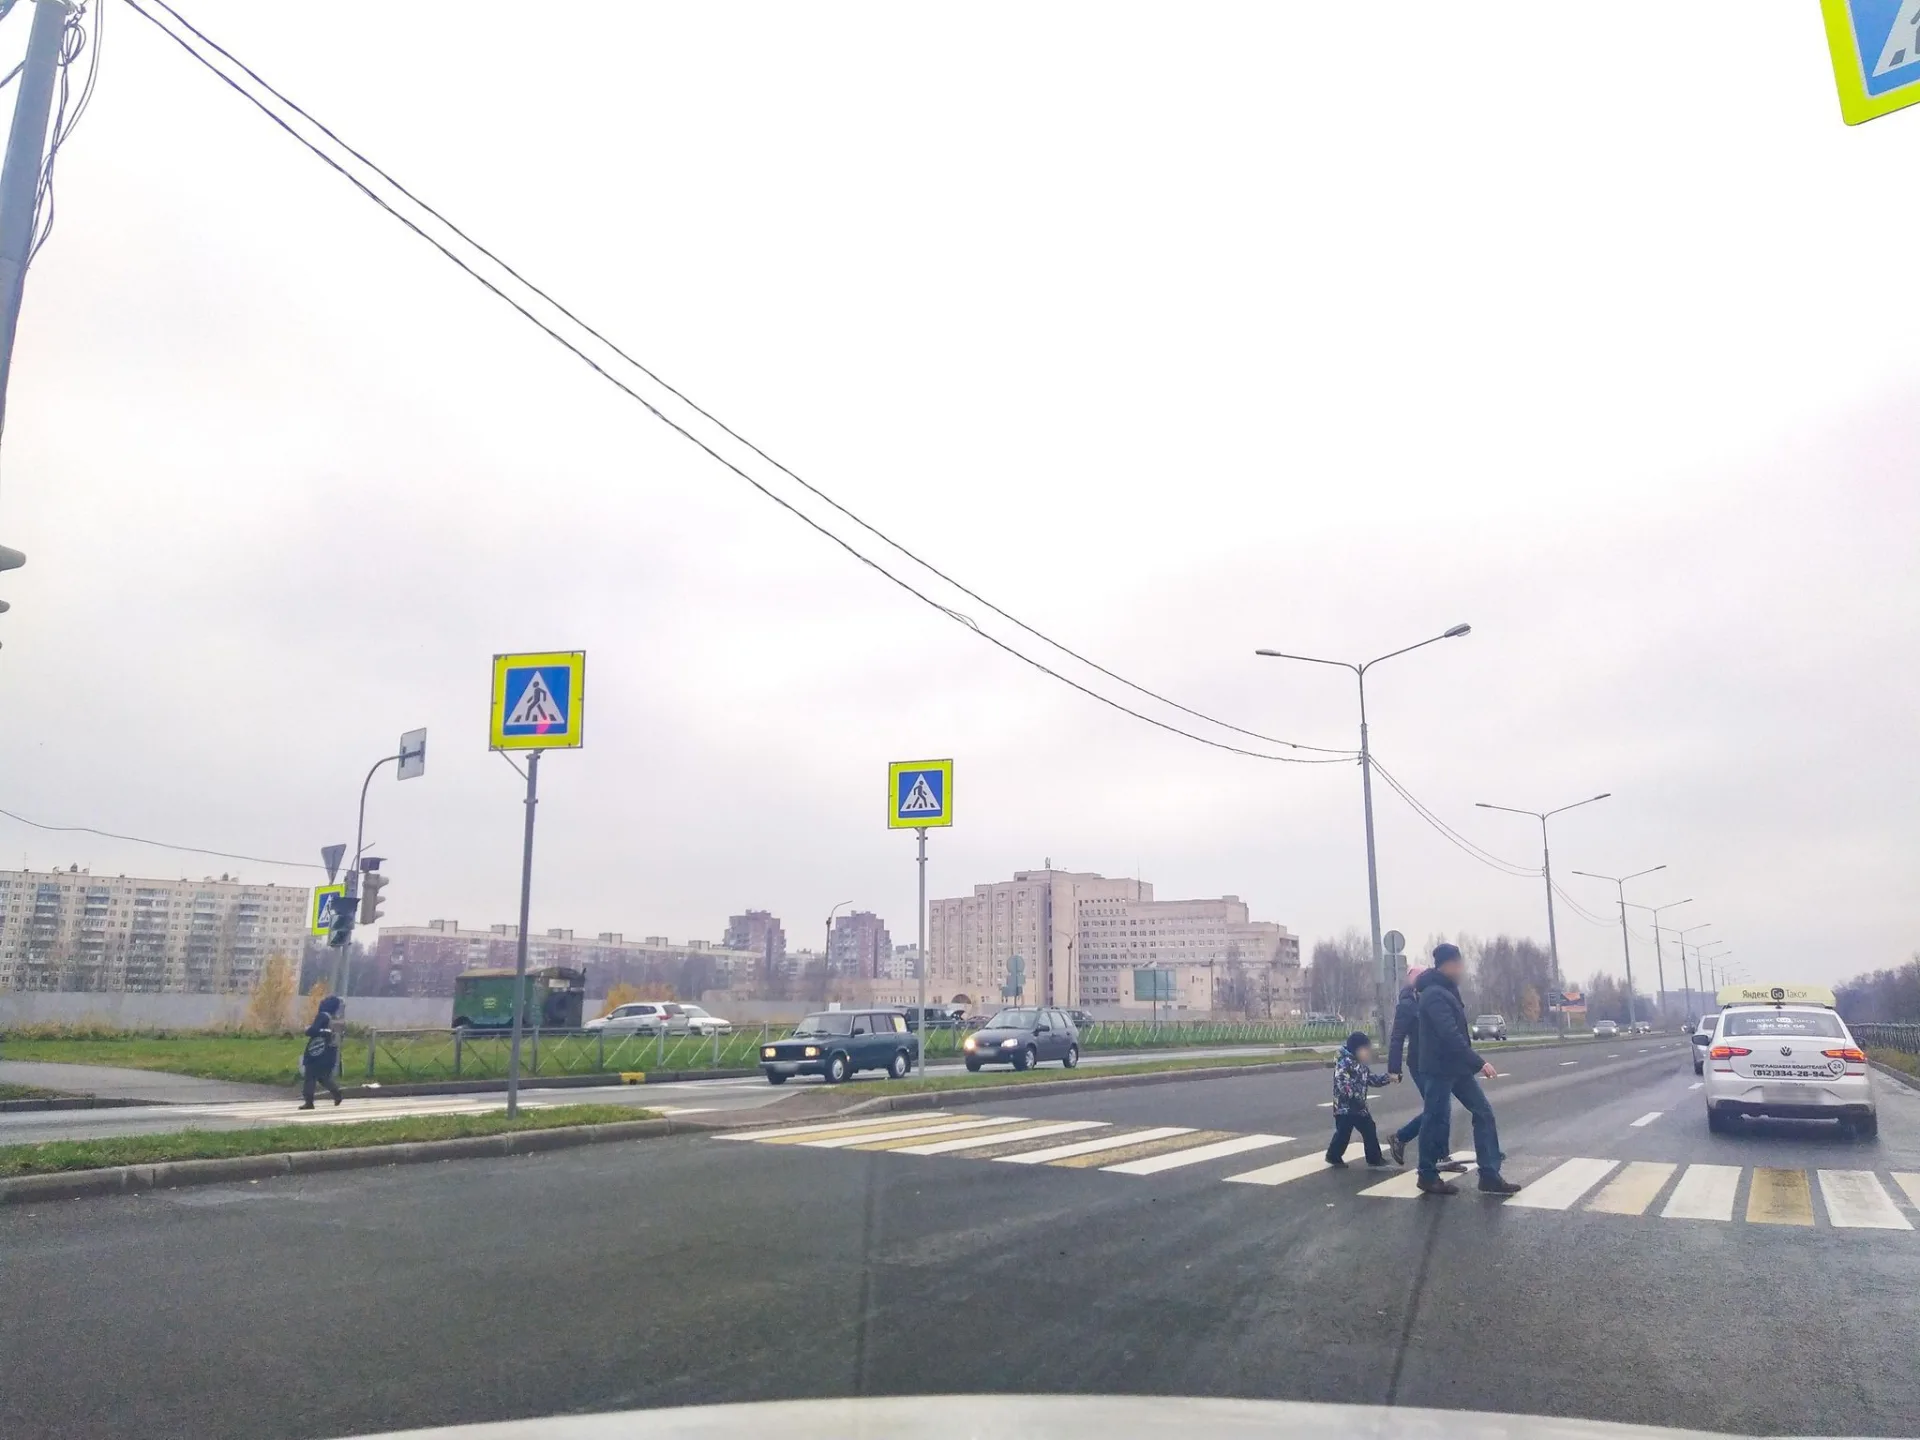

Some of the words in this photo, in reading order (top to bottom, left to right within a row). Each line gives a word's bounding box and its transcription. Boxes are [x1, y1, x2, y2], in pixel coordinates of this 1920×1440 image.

[1742, 990, 1769, 999] Яндекс
[1772, 989, 1783, 999] Go
[1786, 989, 1807, 998] Такси
